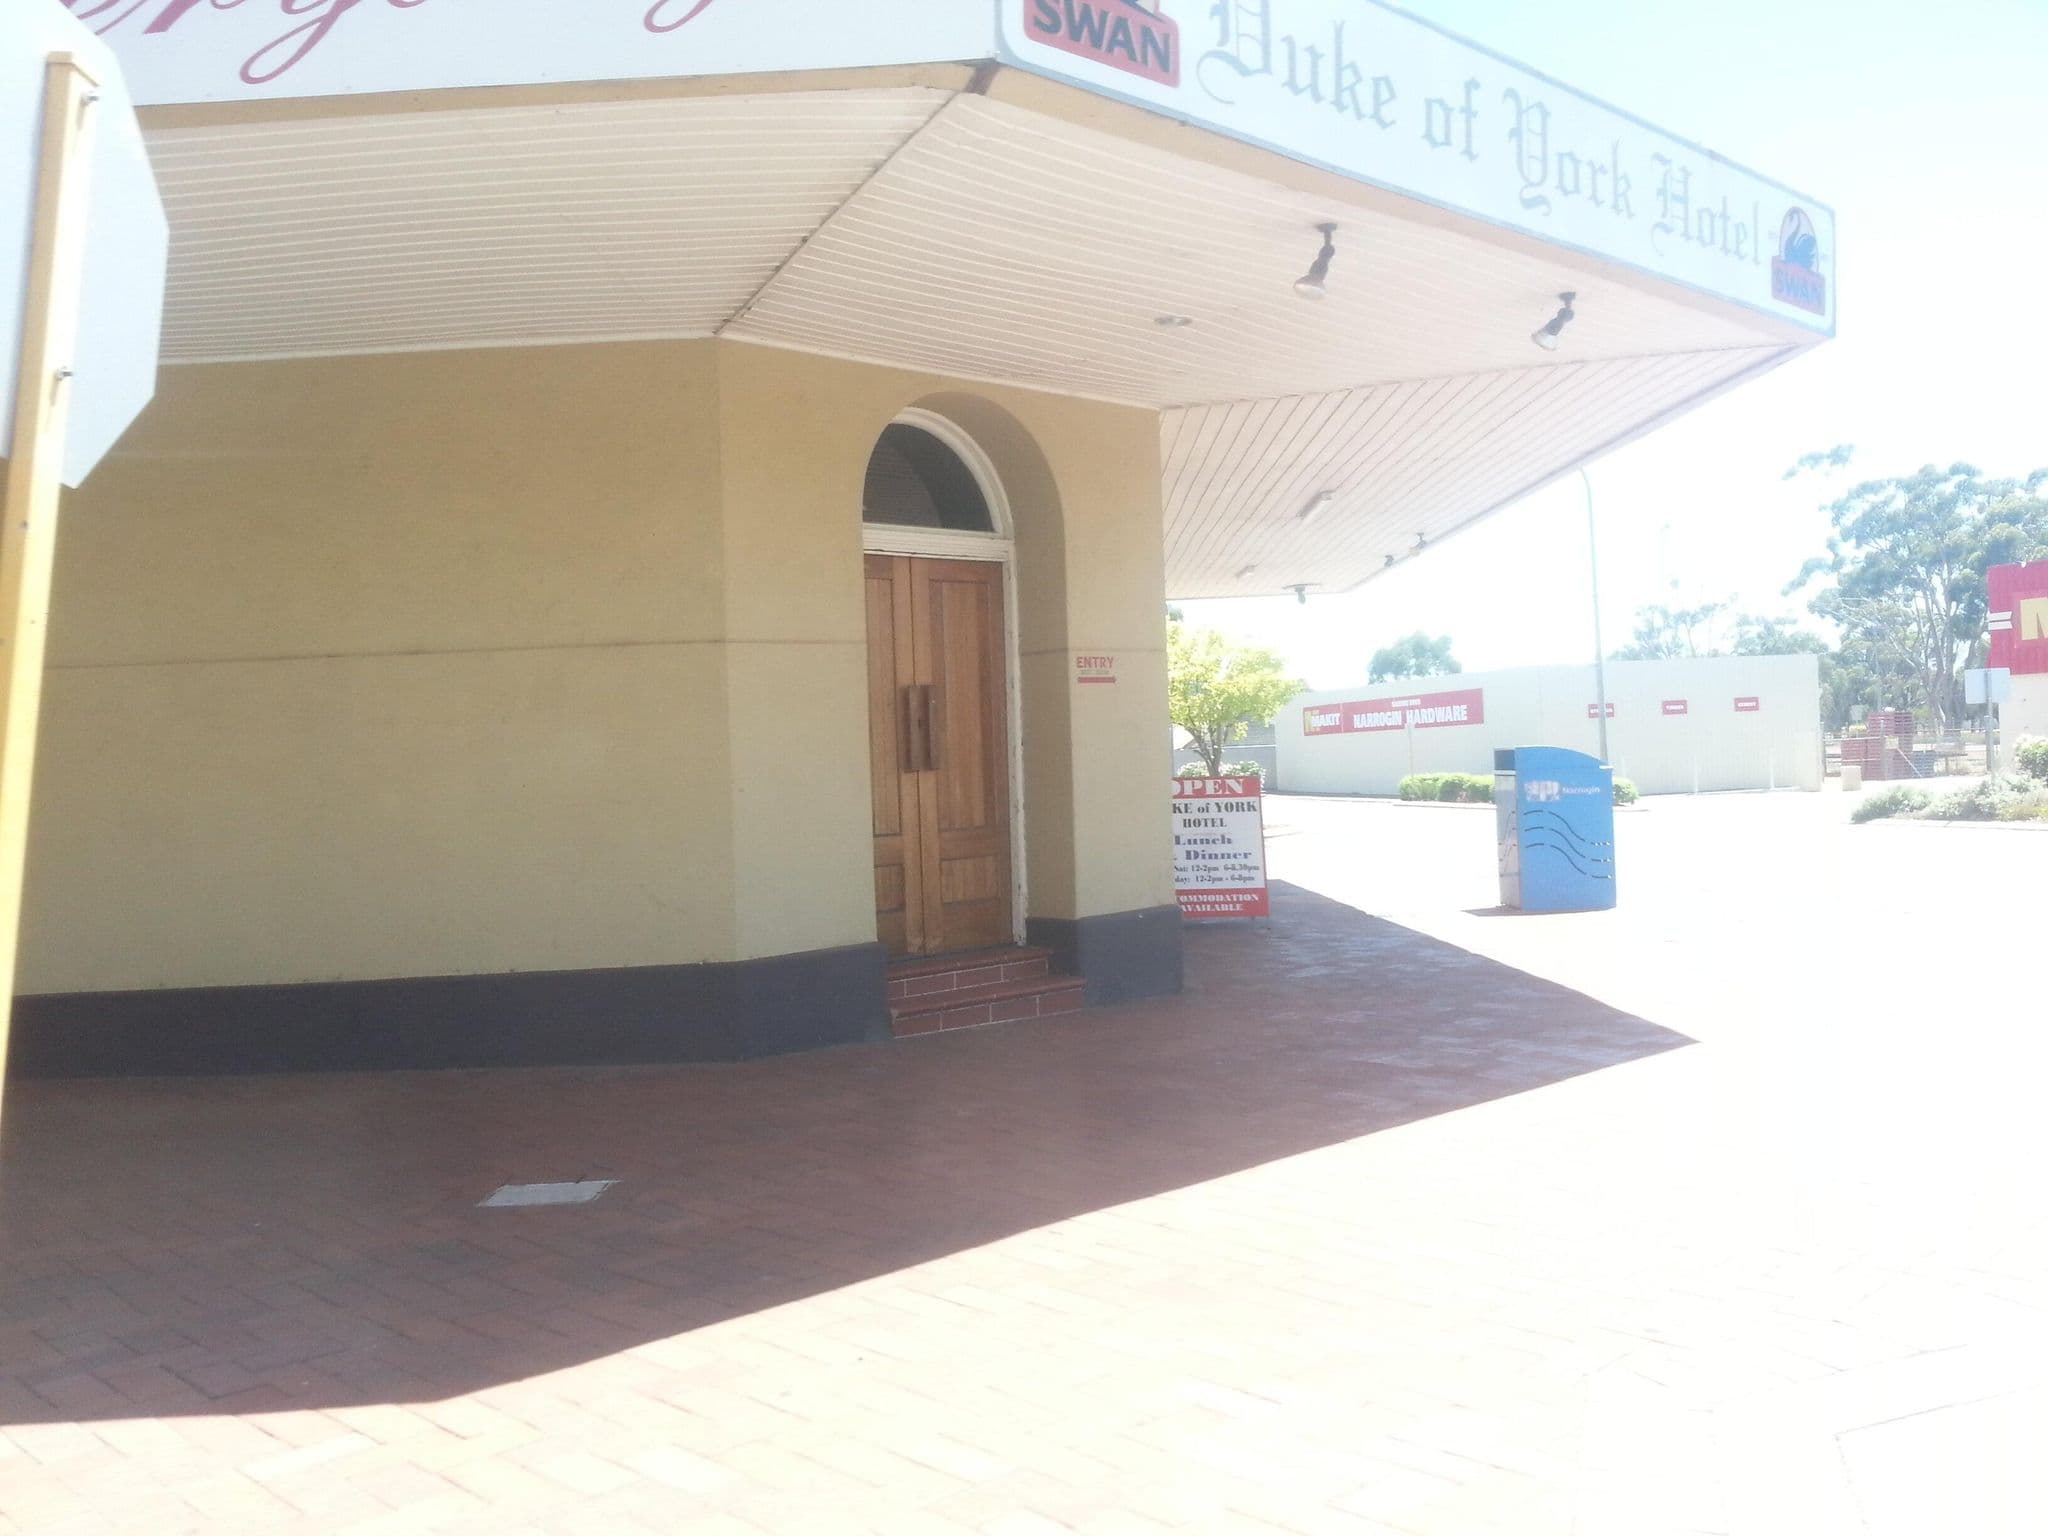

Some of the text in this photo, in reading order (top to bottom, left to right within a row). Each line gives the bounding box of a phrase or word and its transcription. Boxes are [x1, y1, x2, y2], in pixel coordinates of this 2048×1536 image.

[1033, 0, 1171, 73] SWAN
[1197, 0, 1762, 265] Duke of York Hotel
[1774, 268, 1823, 307] SWAN
[1076, 656, 1114, 669] ENTRY
[1406, 704, 1469, 725] HARDWARE
[1171, 779, 1244, 796] OPEN
[1173, 801, 1258, 815] KE of YORK
[1183, 818, 1228, 829] HOTEL
[1174, 834, 1233, 846] Lunch
[1185, 848, 1253, 861] Dinner
[1179, 893, 1259, 903] OMMODATION
